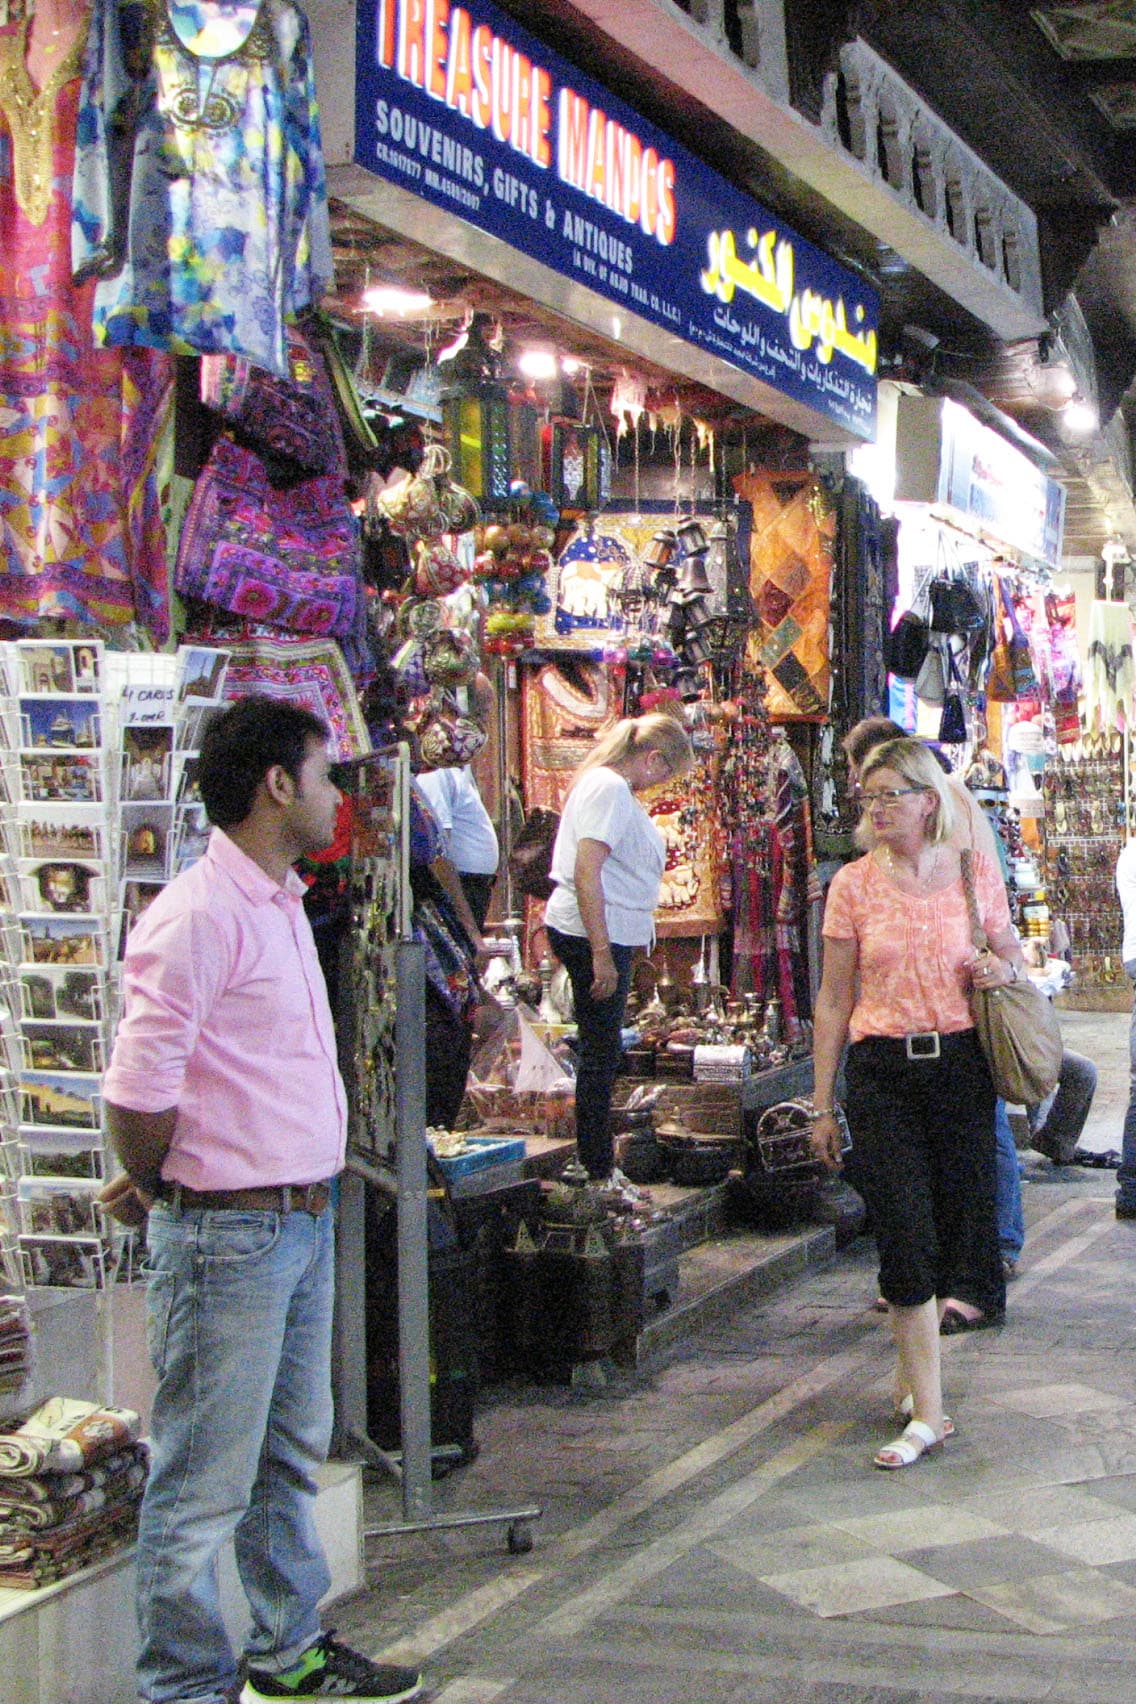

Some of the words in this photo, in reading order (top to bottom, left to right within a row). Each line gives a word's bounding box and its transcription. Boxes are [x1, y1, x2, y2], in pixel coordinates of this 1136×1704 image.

[377, 0, 553, 168] TREASURE
[376, 99, 489, 197] SOUVENIRS,
[493, 166, 539, 220] GIFTS
[545, 199, 556, 230] &
[563, 209, 633, 274] ANTIQUES
